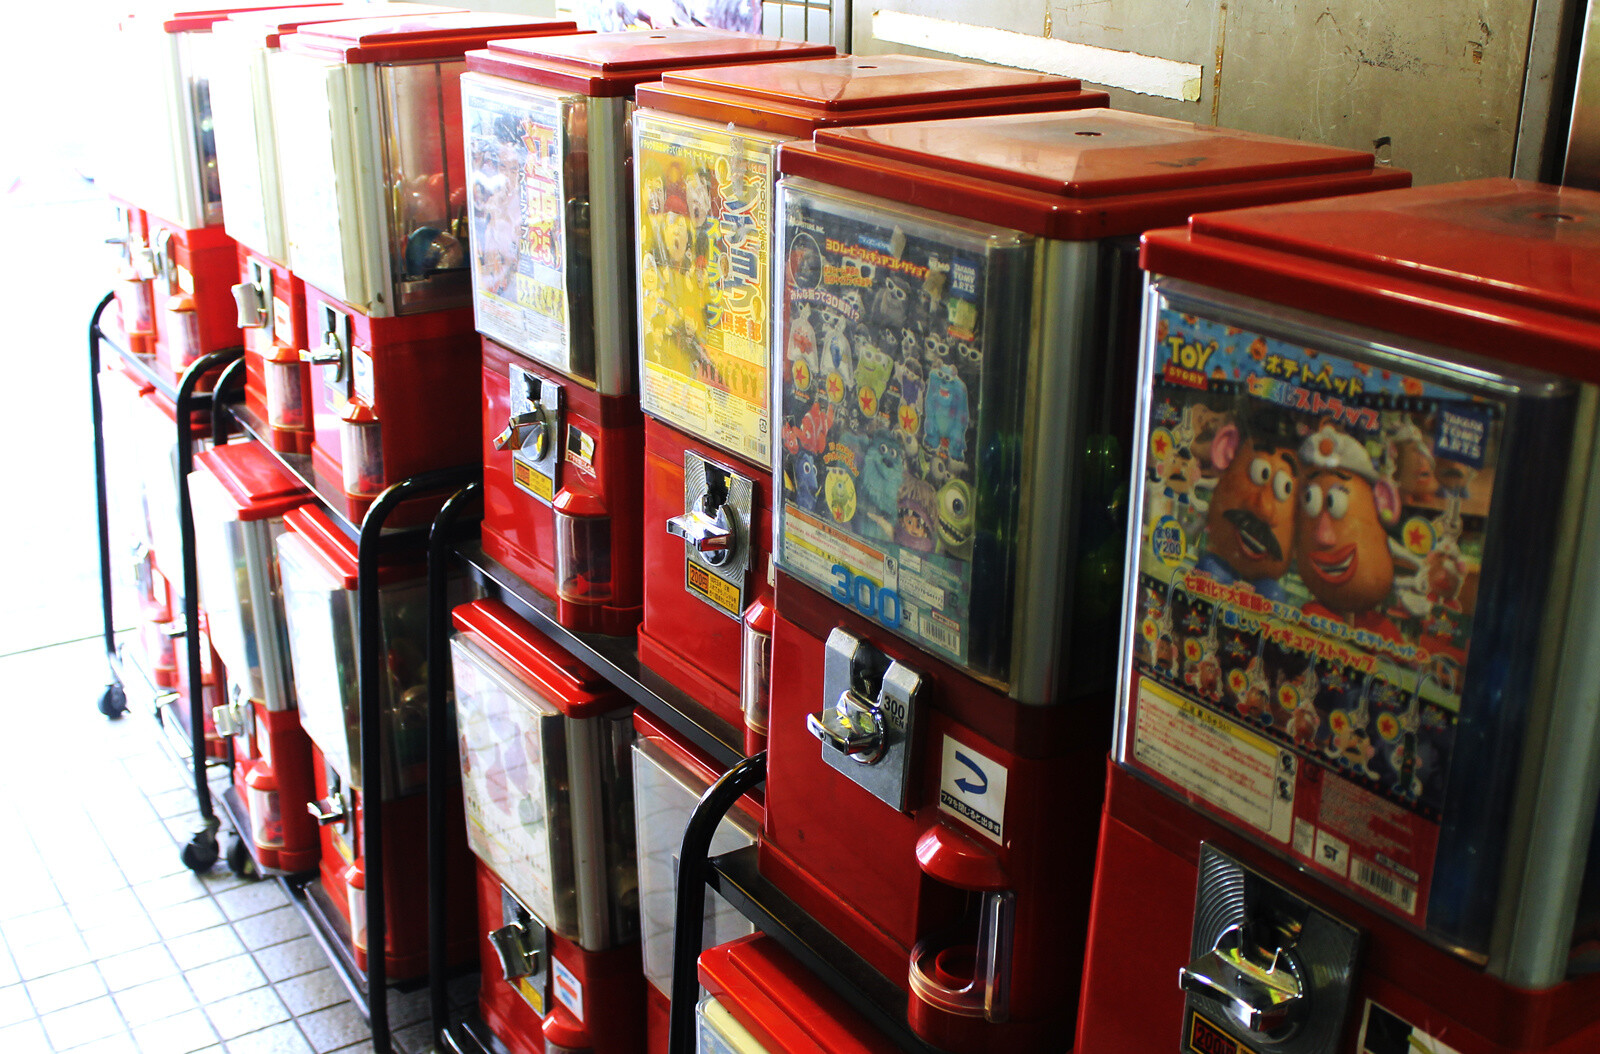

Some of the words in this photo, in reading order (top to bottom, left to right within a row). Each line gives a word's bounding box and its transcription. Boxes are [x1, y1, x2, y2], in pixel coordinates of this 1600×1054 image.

[706, 217, 723, 327] ストラップ
[953, 272, 975, 285] TOMY
[951, 280, 975, 294] ARTS
[1168, 336, 1213, 371] TOY
[1169, 366, 1205, 385] STORY
[1263, 353, 1364, 395] ポテトヘッド
[1441, 423, 1483, 443] TOMY
[1438, 435, 1481, 459] ARTS
[831, 564, 900, 629] 300
[883, 695, 905, 720] 300
[891, 716, 904, 729] YEN
